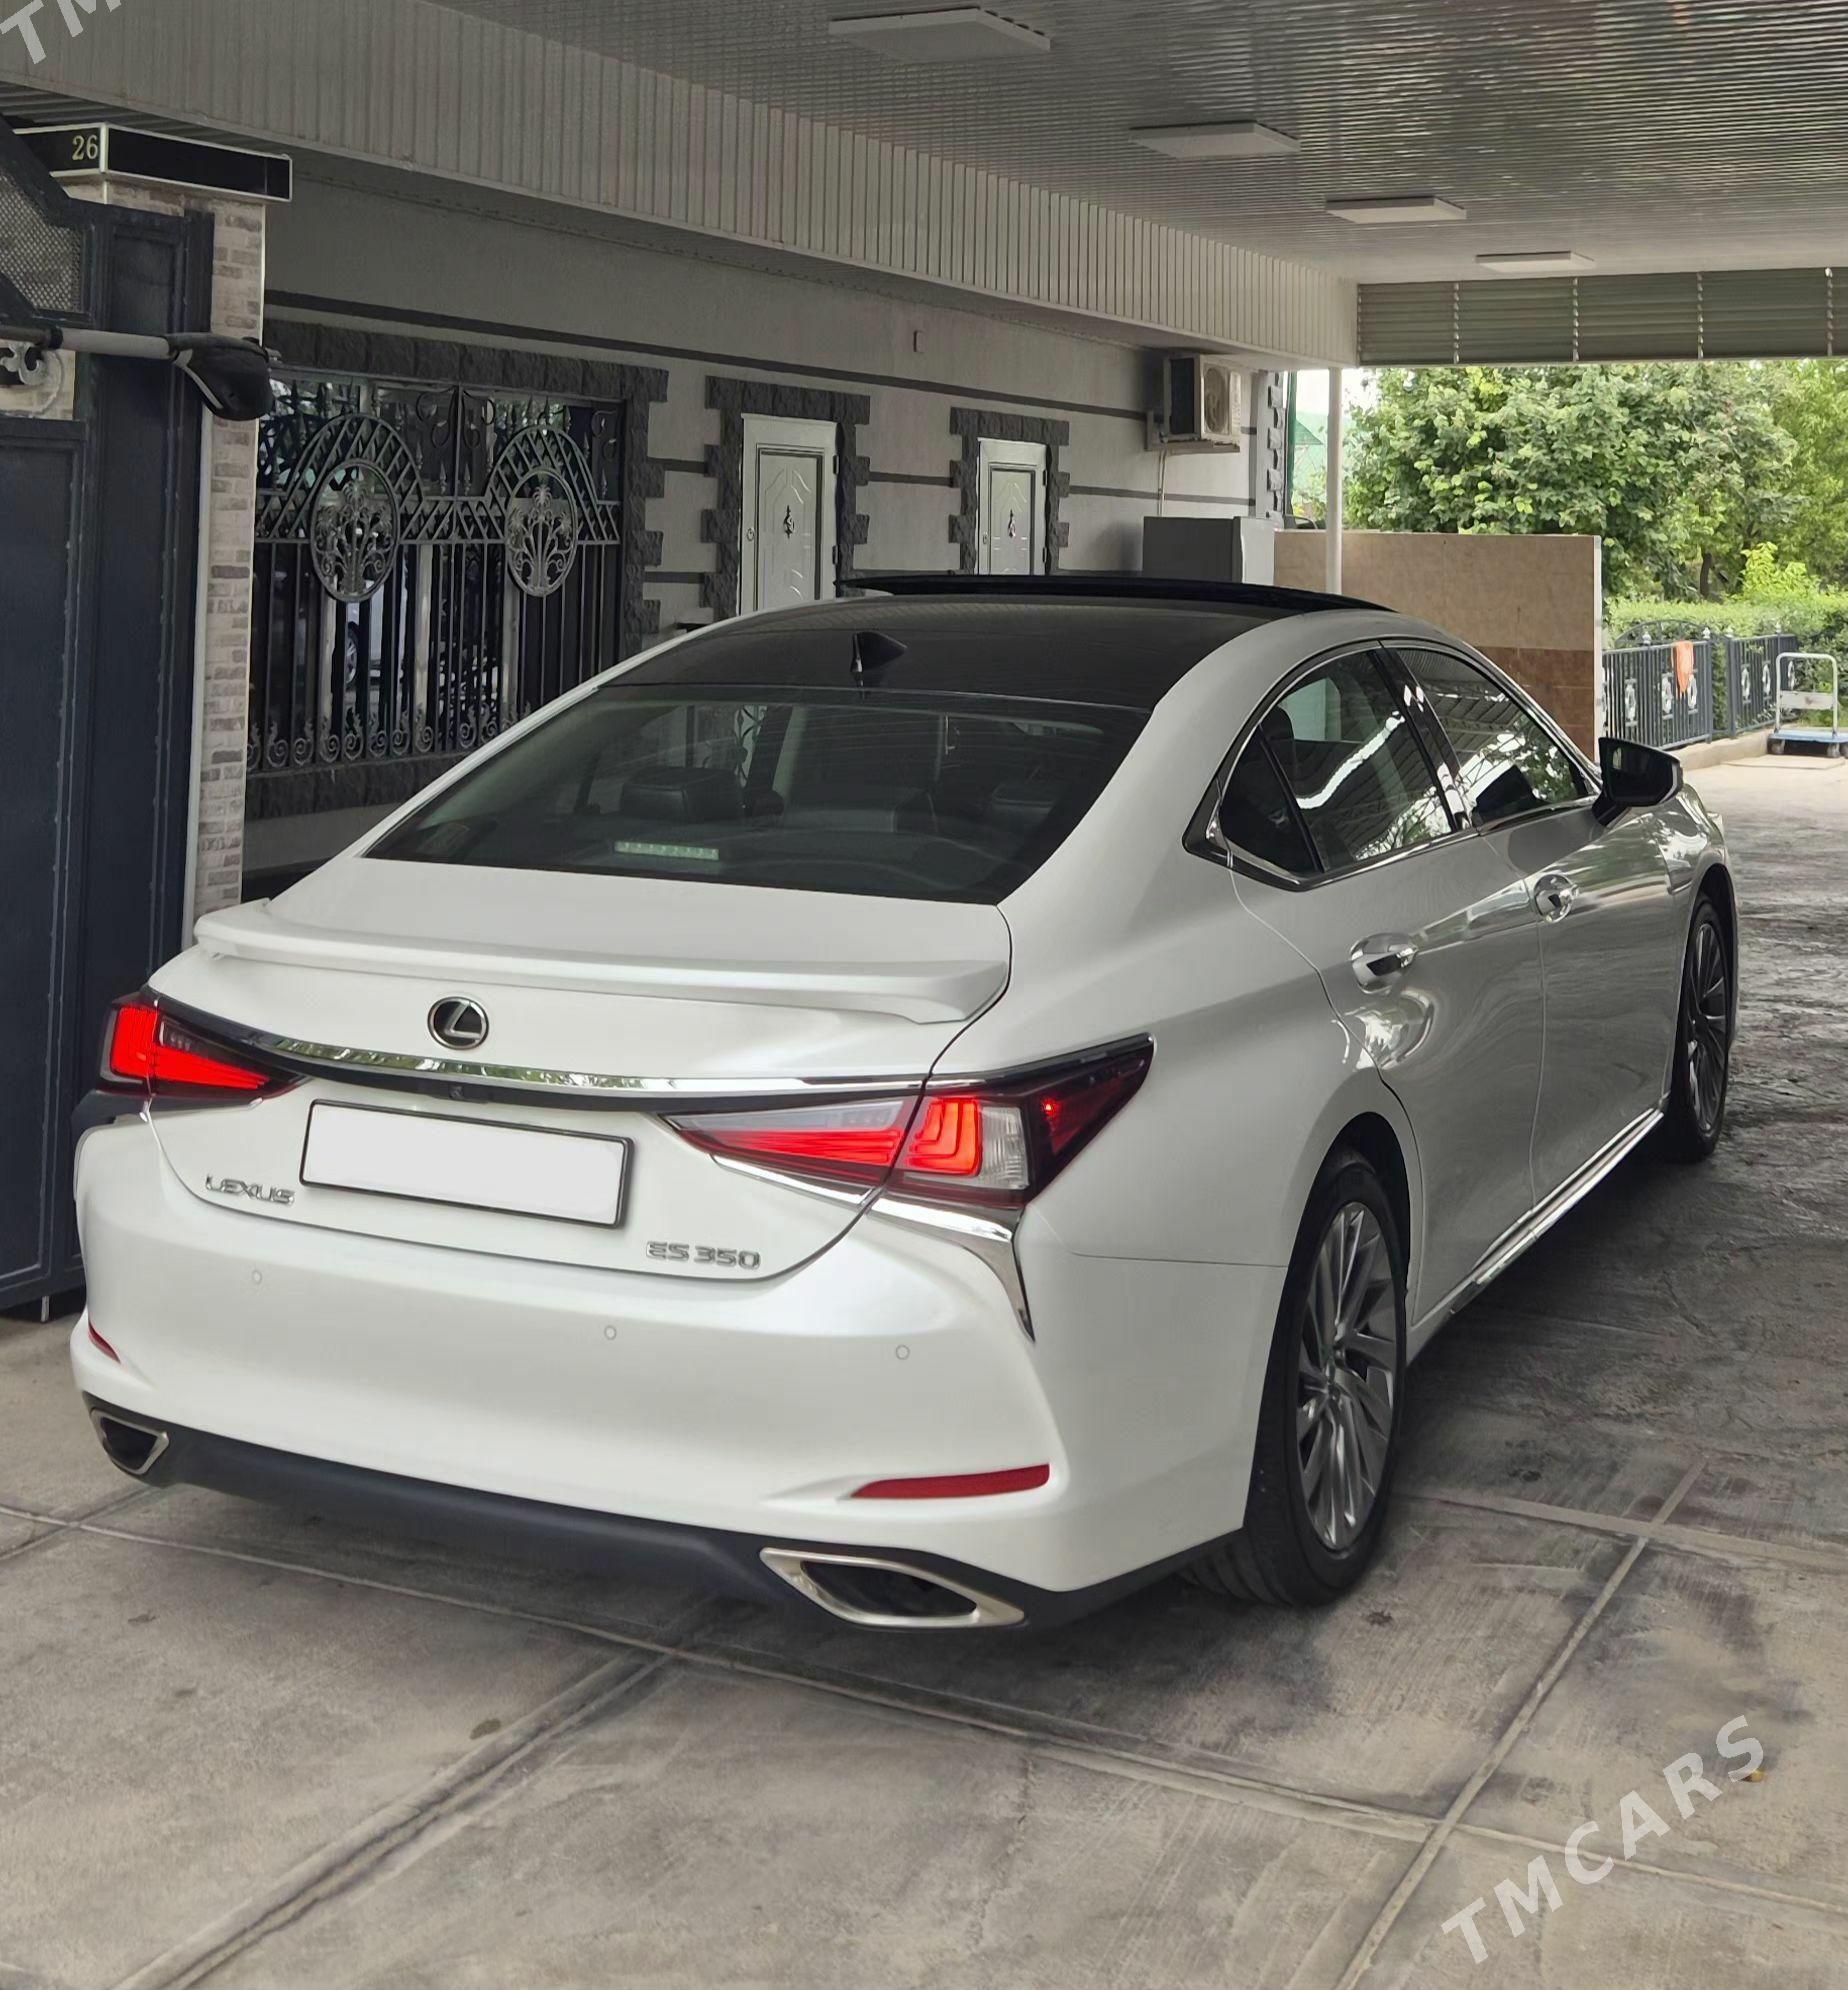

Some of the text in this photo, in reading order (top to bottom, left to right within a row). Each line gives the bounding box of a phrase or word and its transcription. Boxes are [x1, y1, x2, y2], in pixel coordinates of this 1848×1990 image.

[72, 134, 98, 161] 26
[205, 1174, 295, 1205] LEXUS
[646, 1240, 761, 1269] ES 350
